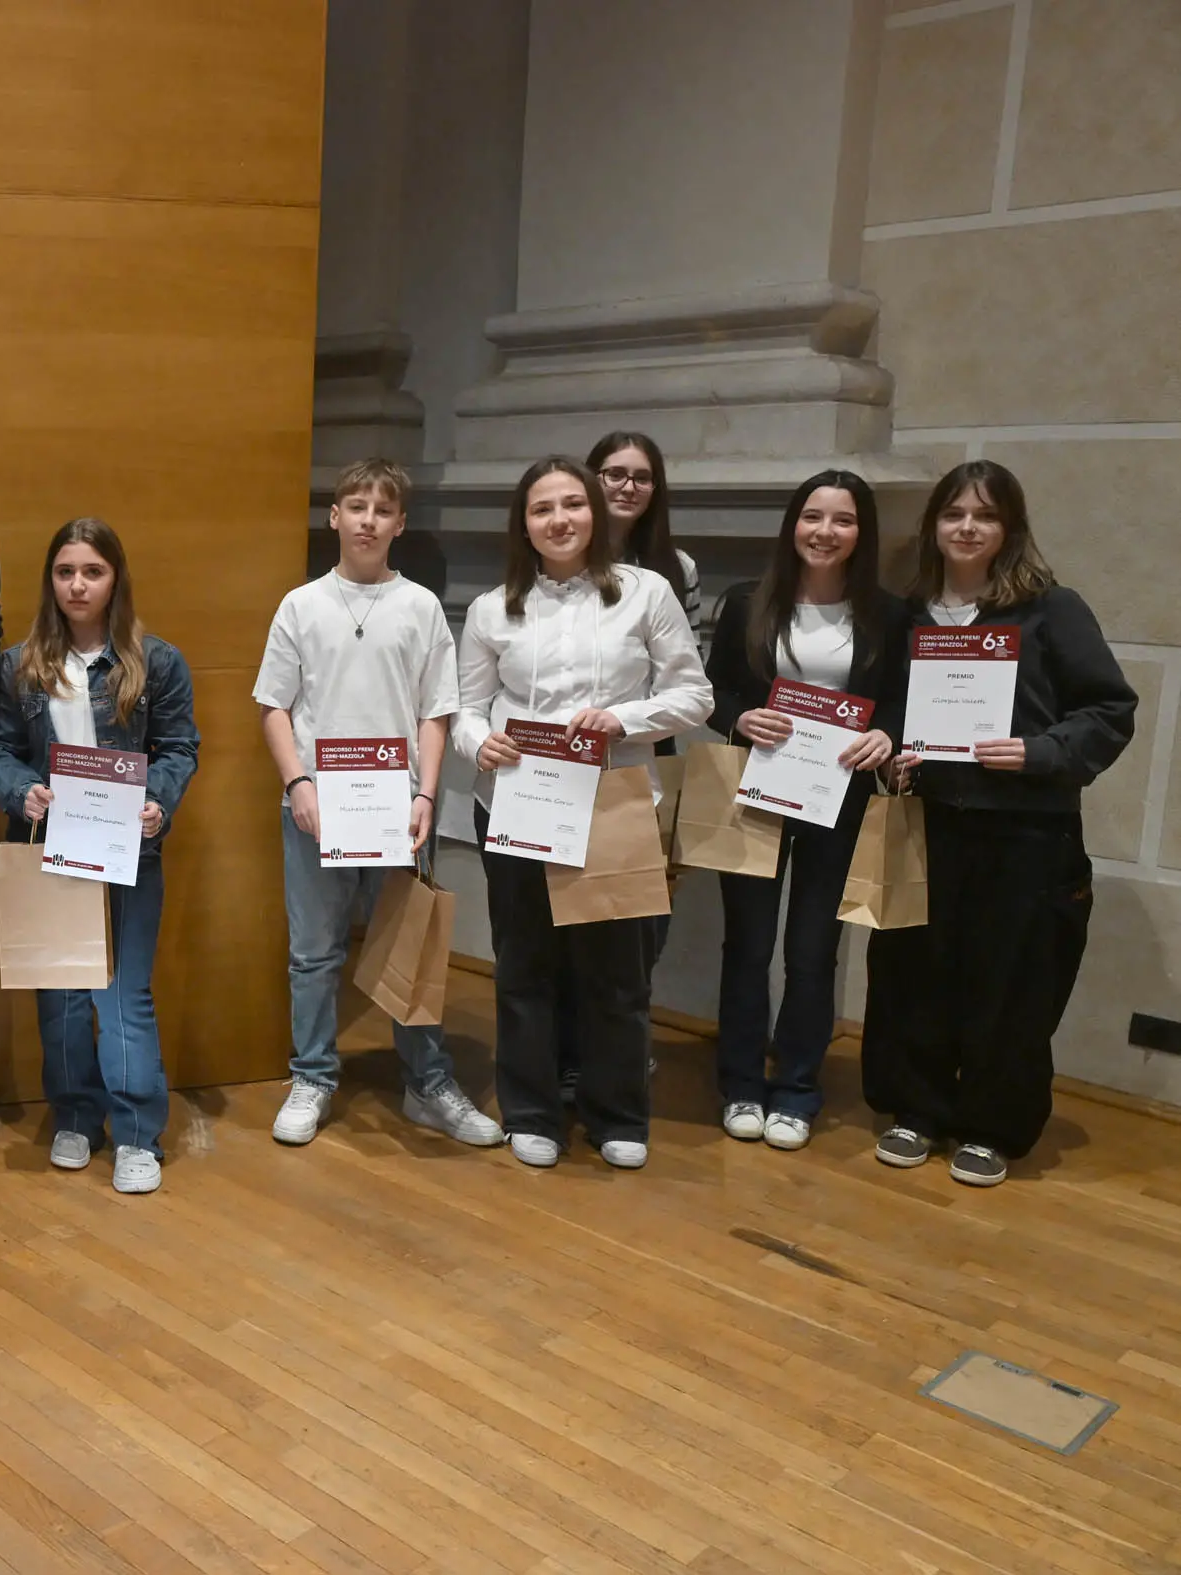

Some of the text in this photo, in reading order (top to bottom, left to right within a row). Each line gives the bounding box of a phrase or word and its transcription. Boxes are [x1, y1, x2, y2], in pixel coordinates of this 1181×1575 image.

[778, 687, 812, 699] CONCORSO
[817, 695, 837, 705] PREMI
[776, 693, 823, 710] CERRI-MAZZOLA
[511, 727, 545, 737] CONCORSO
[795, 730, 823, 741] PREMIO
[56, 751, 89, 760] CONCORSO
[56, 758, 102, 769] CERRI-MAZZOLA
[533, 769, 560, 779] PREMIO
[84, 790, 109, 799] PREMIO
